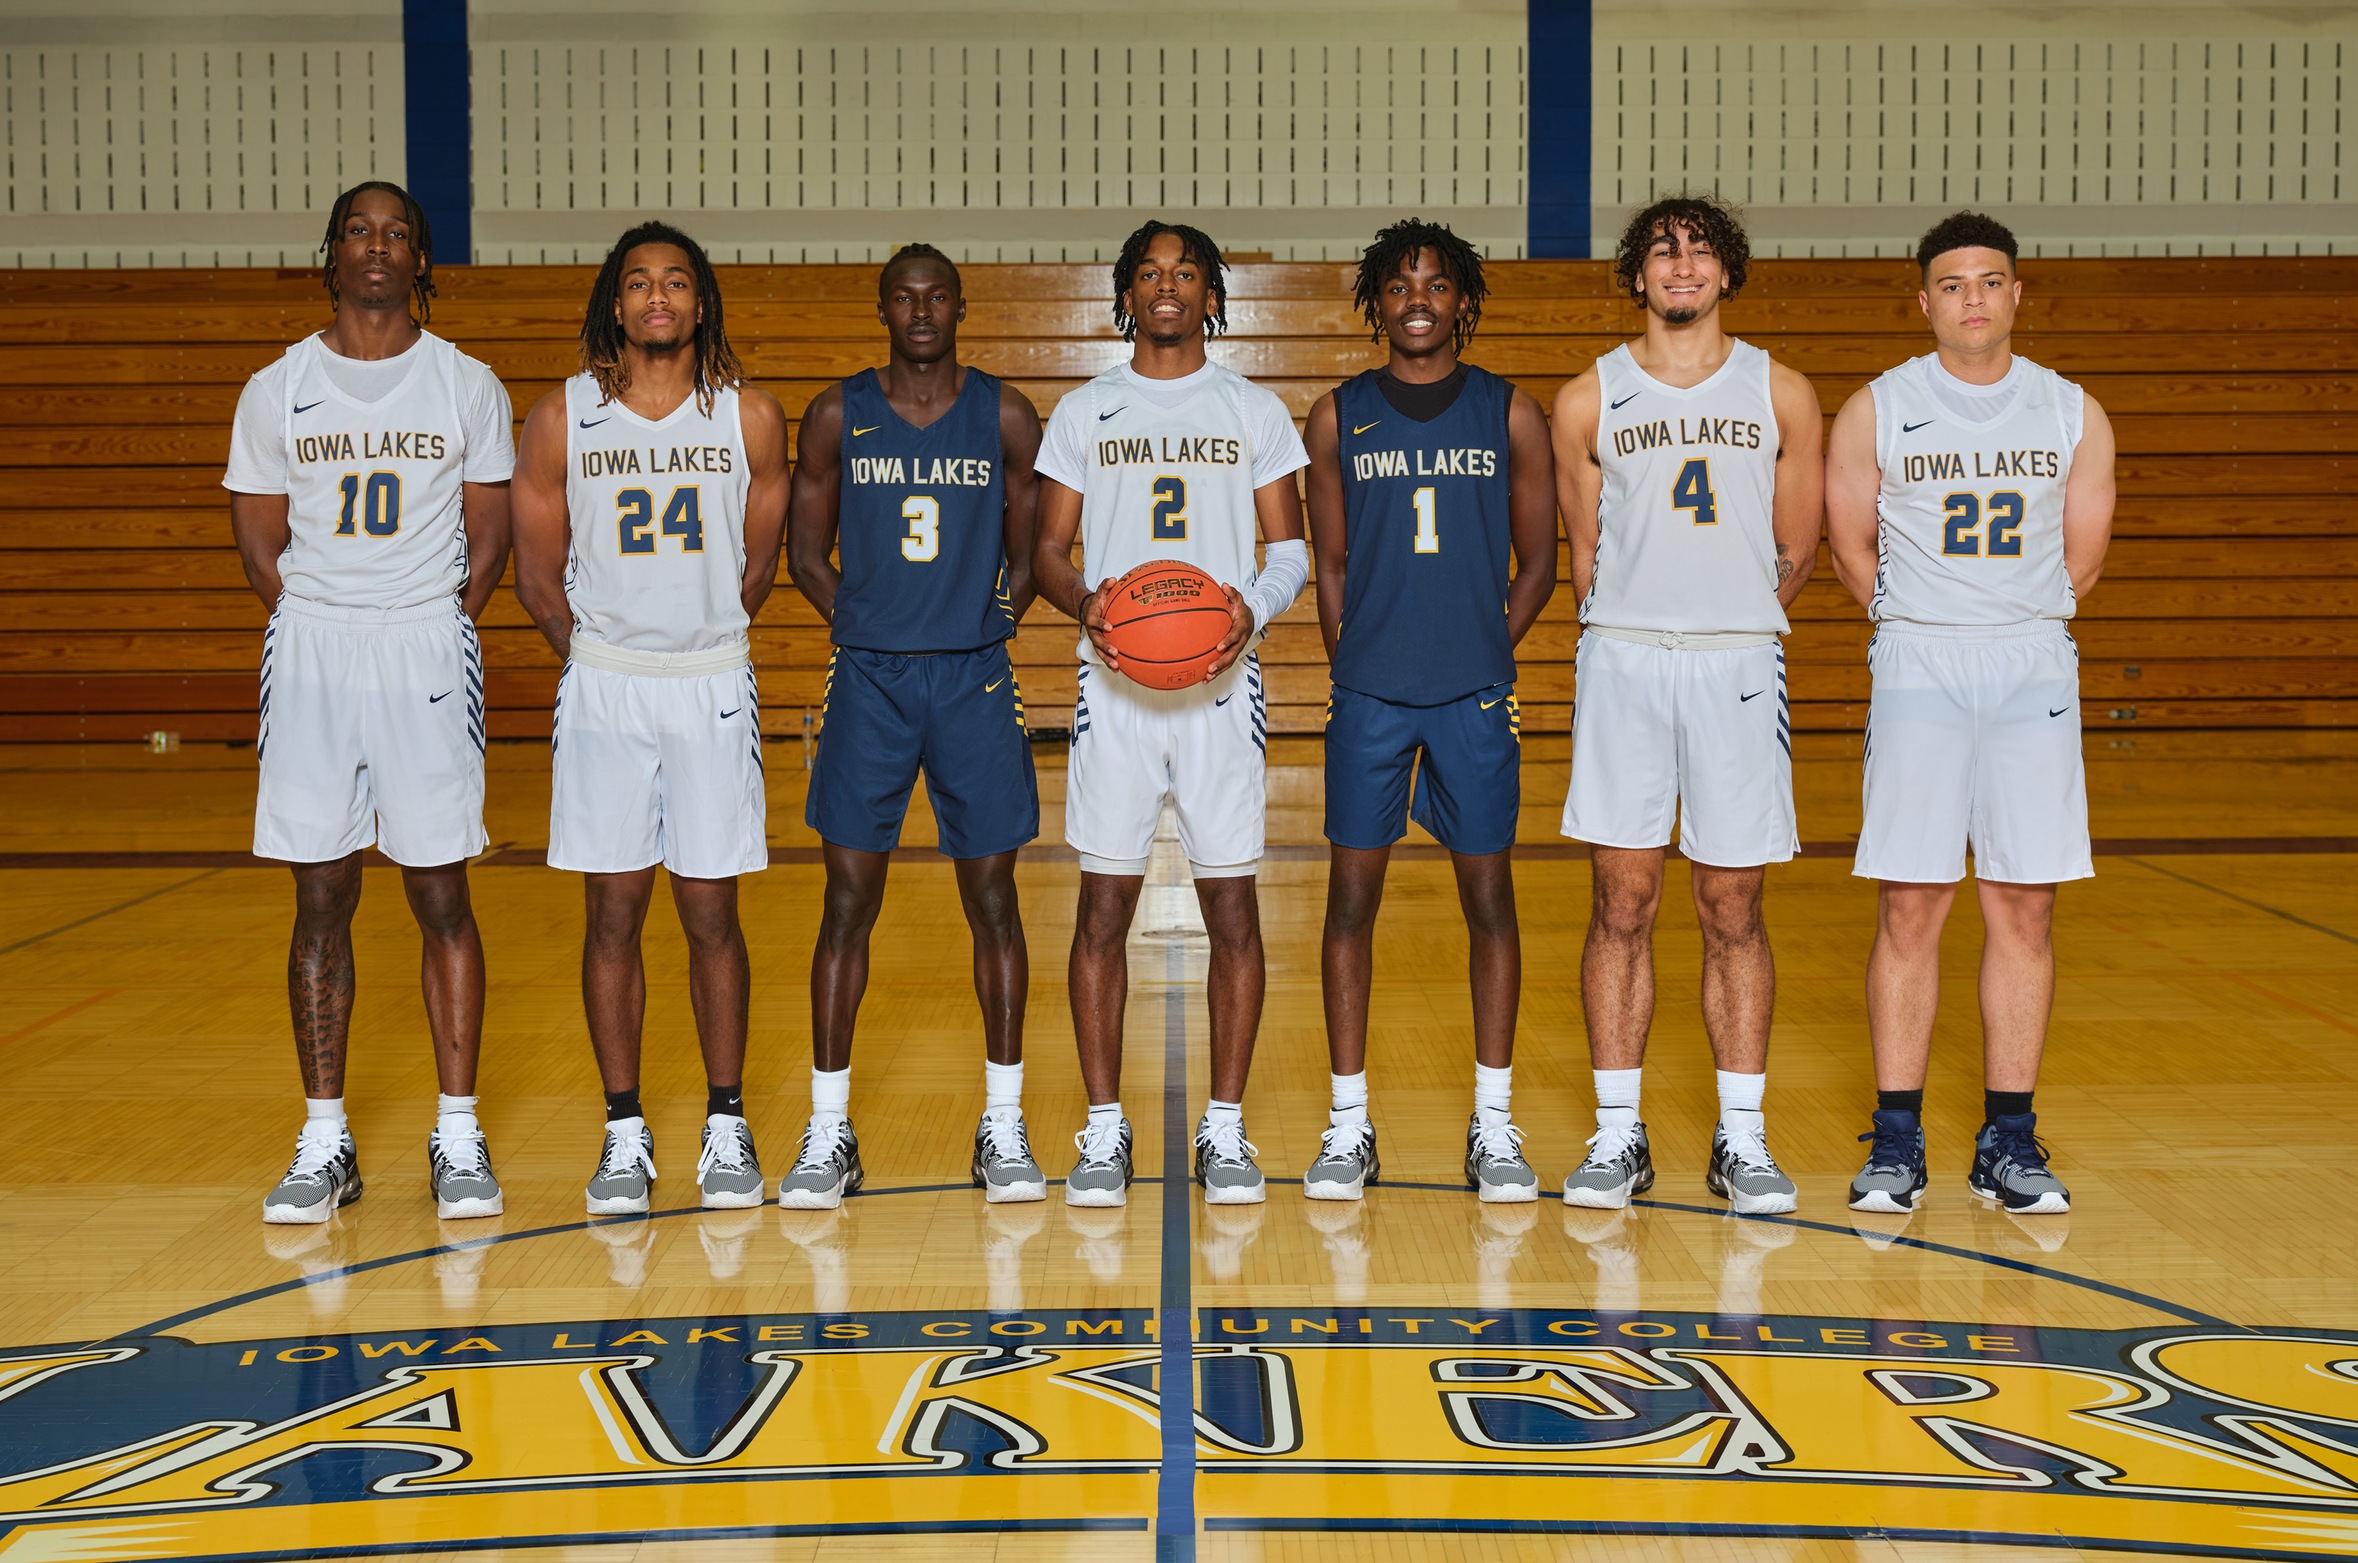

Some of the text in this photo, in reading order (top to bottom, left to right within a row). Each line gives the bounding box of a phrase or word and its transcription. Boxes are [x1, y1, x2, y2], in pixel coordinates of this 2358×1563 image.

[295, 430, 446, 465] IOWA LAKES
[1098, 435, 1240, 467] IOWA LAKES
[1612, 416, 1762, 458] IOWA LAKES
[581, 446, 733, 479] IOWA LAKES
[850, 456, 992, 488] IOWA LAKES
[1353, 447, 1497, 482] IOWA LAKES
[1903, 449, 2059, 484] IOWA LAKES
[333, 469, 403, 539] 10
[1150, 474, 1189, 542] 2
[1670, 456, 1719, 527] 4
[615, 484, 705, 557] 24
[900, 494, 940, 563] 3
[1412, 486, 1440, 554] 1
[1940, 489, 2027, 559] 22
[1130, 578, 1204, 600] LEGACY
[1156, 589, 1201, 599] 1000
[238, 1336, 503, 1366] IOWA
[551, 1322, 871, 1349] LAKES
[1547, 1318, 2022, 1353] COLLEGE
